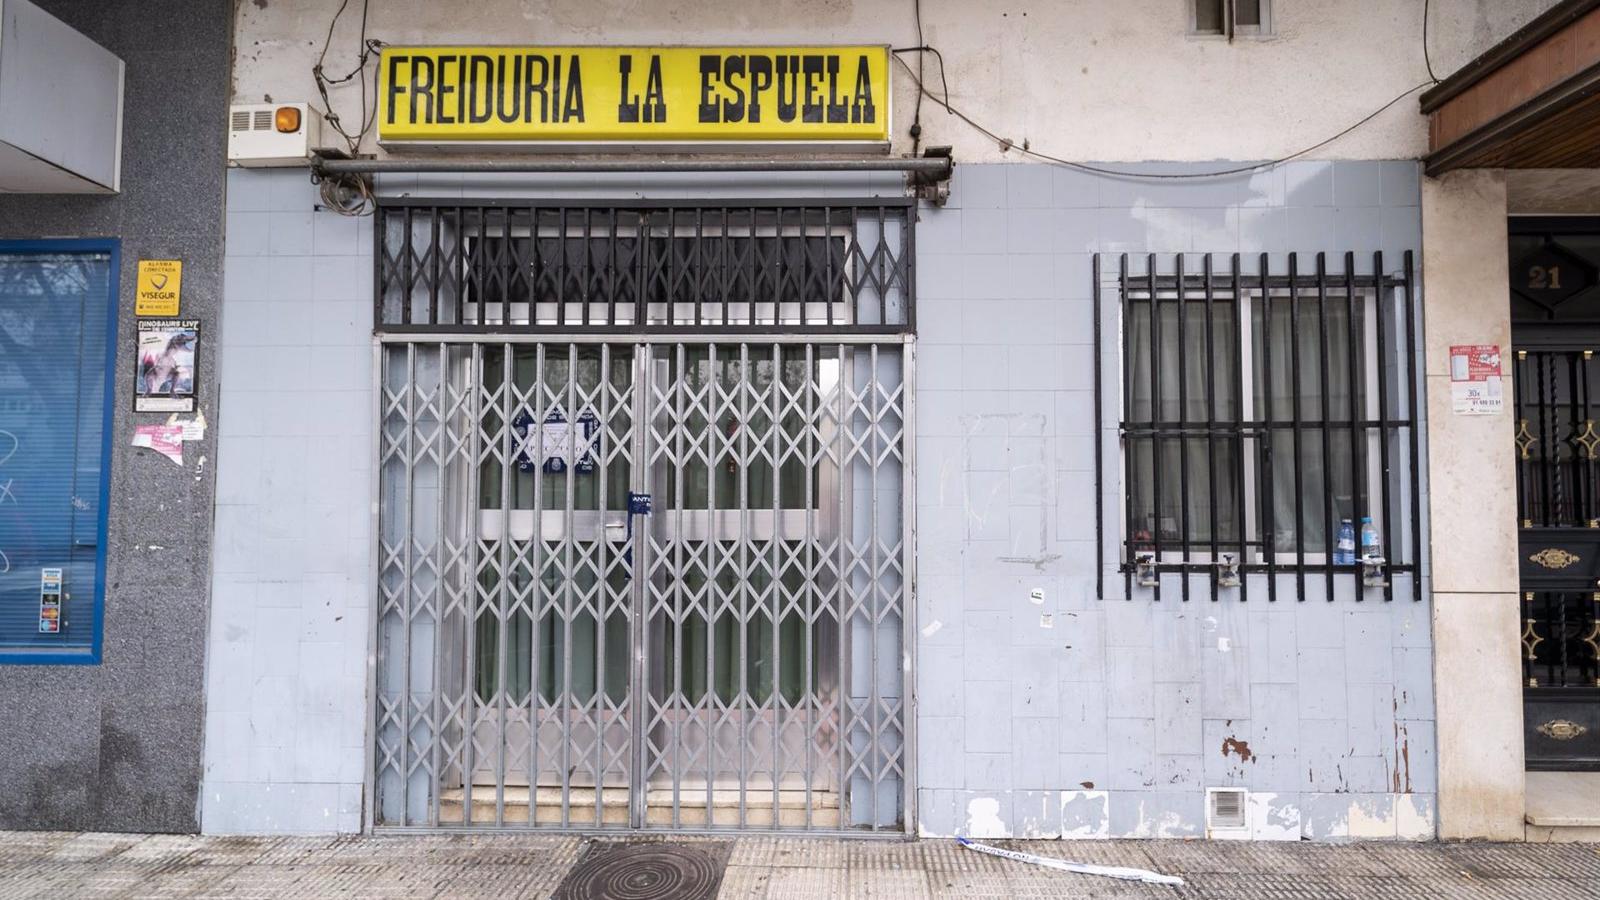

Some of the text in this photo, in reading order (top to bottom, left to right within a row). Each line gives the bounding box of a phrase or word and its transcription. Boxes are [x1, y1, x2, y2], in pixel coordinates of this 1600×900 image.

[387, 54, 876, 124] FREIDURIA LA ESPUELA
[1528, 265, 1561, 289] 21
[141, 291, 176, 300] VISEGUR
[138, 320, 181, 331] DINOSAURS
[182, 320, 199, 331] LIVE
